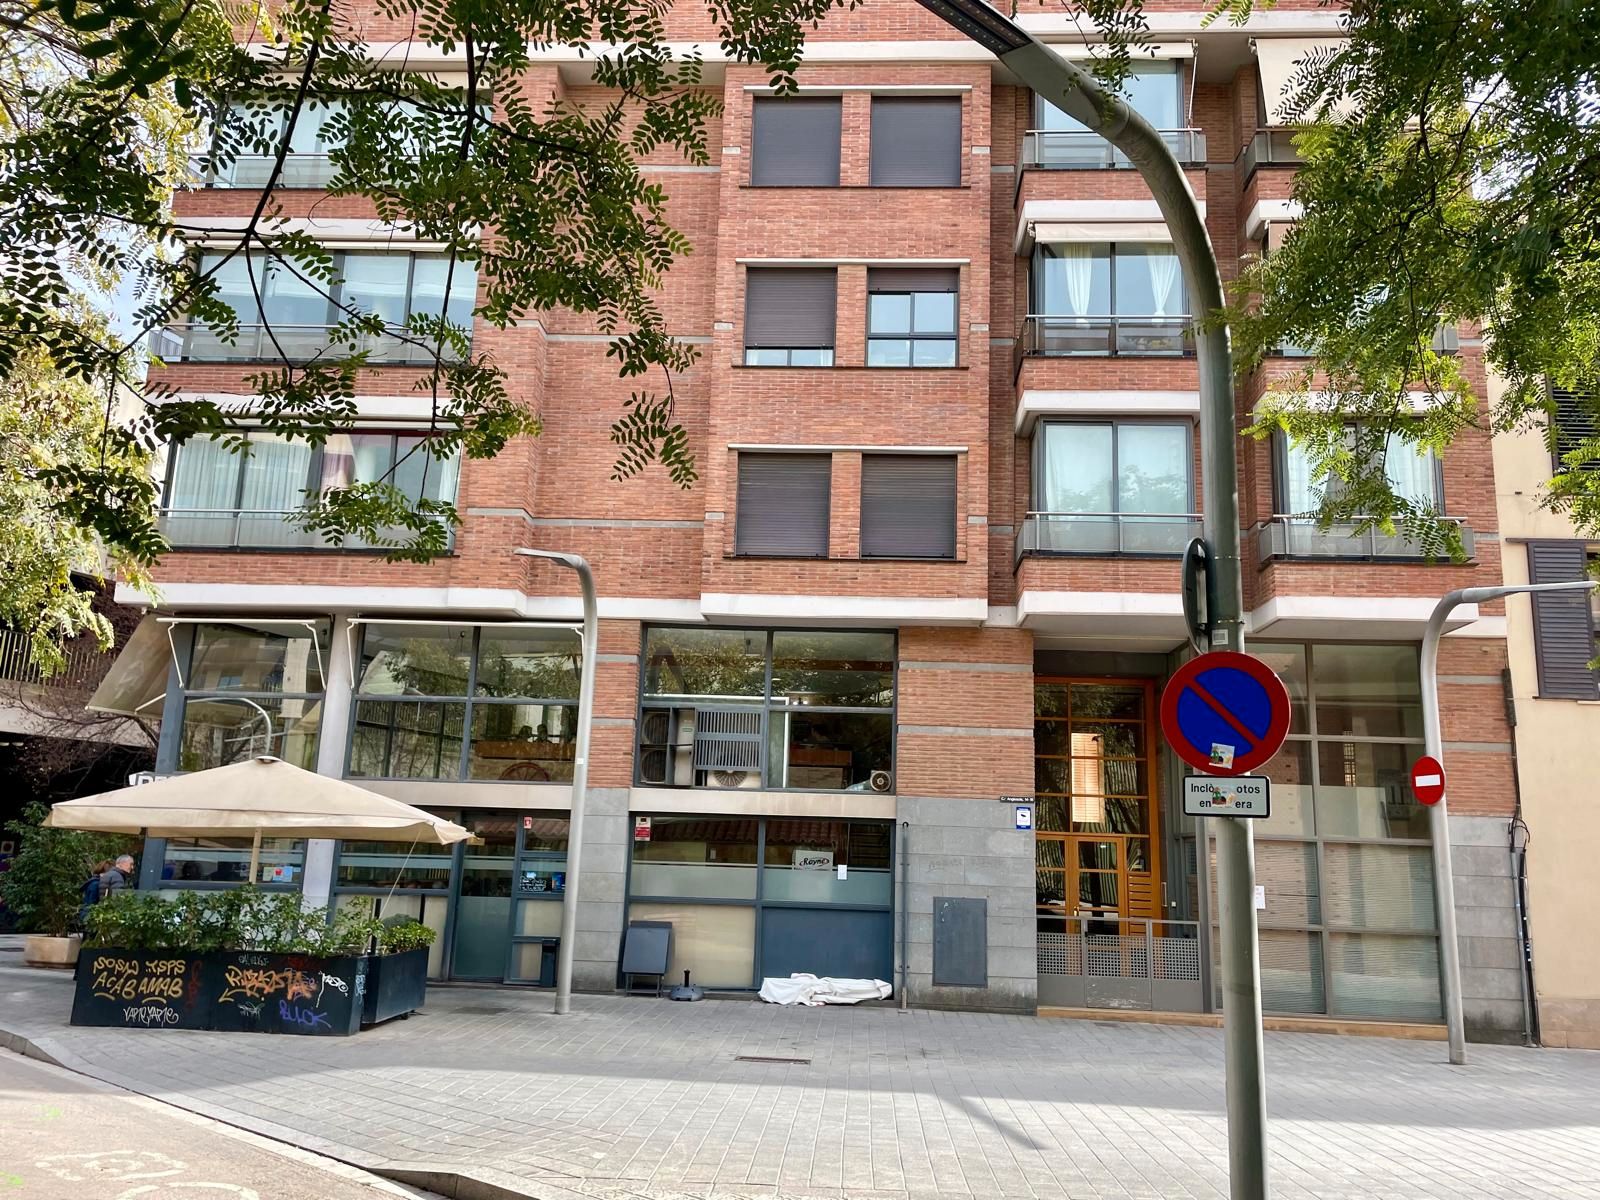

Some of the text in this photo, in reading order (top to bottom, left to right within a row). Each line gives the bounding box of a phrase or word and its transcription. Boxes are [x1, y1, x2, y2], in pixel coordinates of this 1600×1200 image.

[1190, 783, 1261, 794] Inclò otos
[1199, 800, 1212, 808] en
